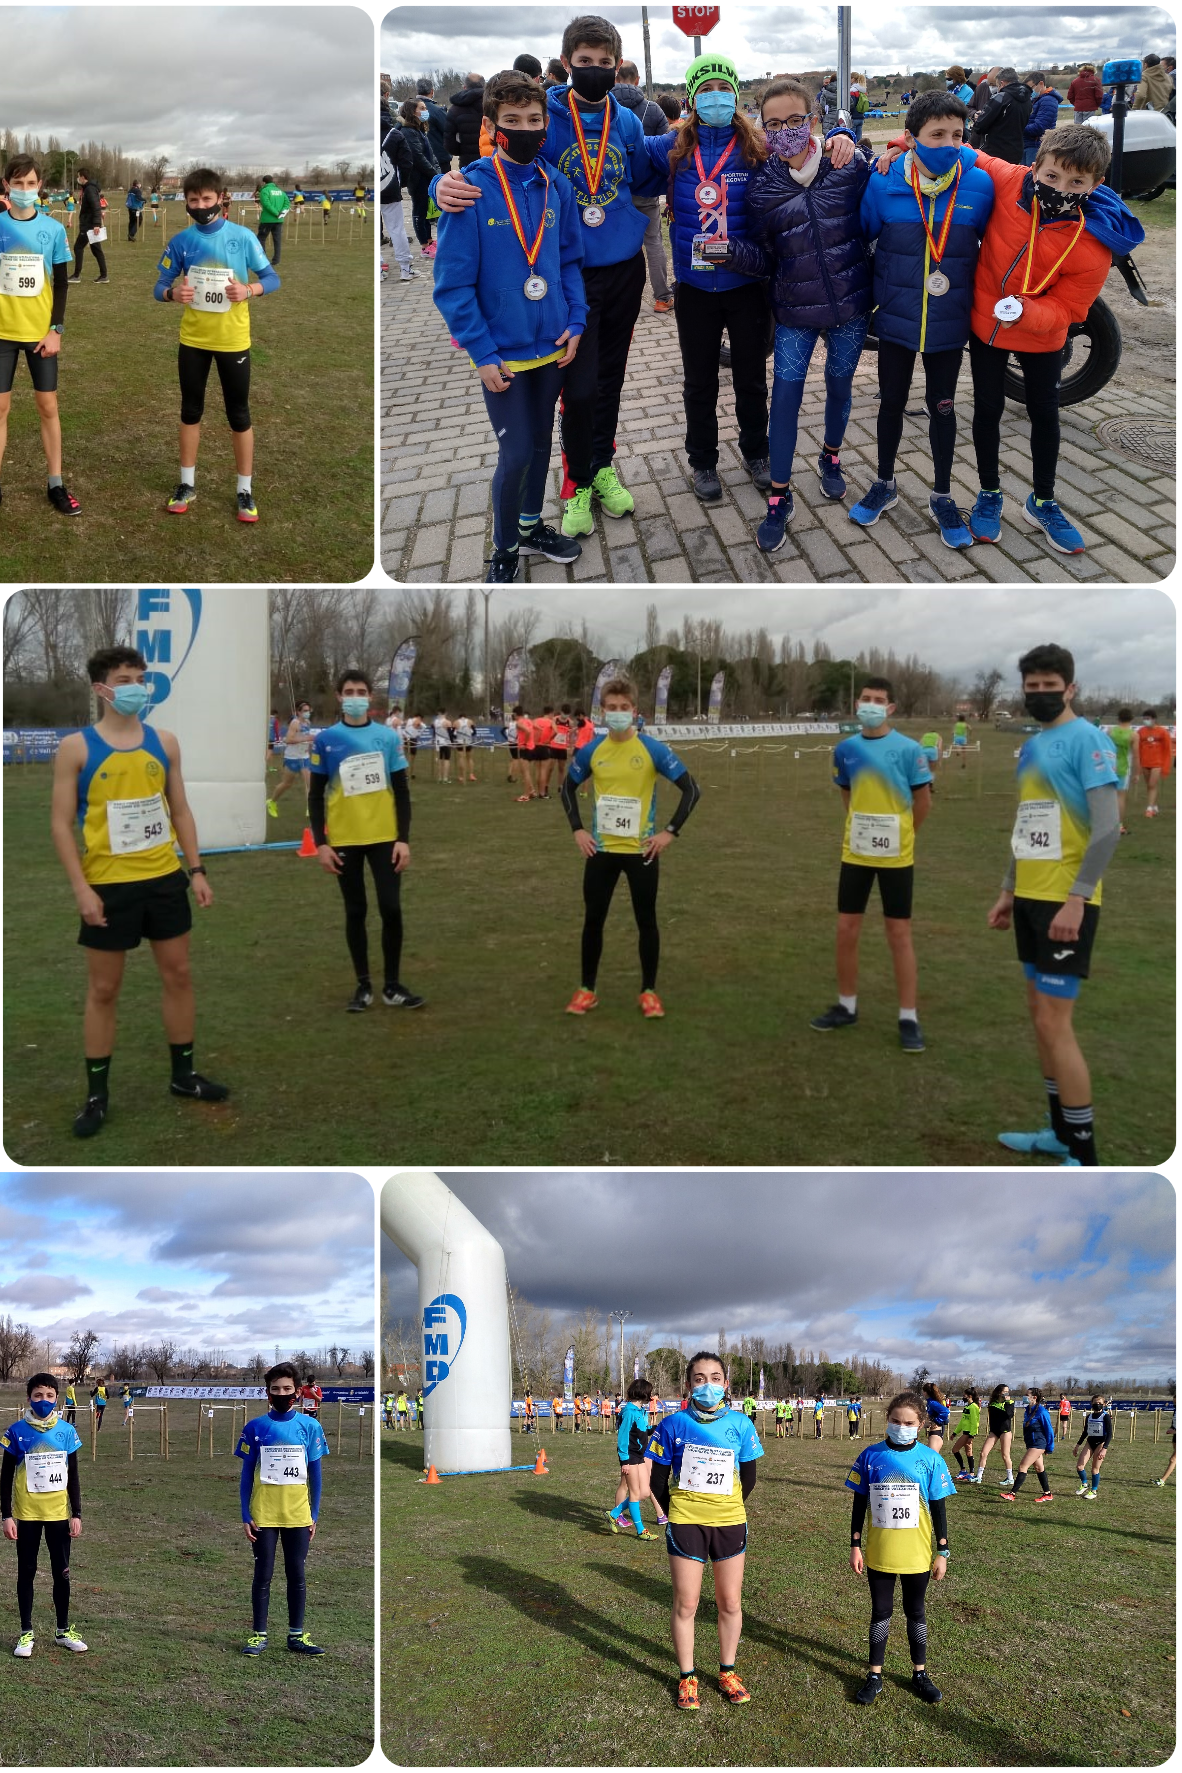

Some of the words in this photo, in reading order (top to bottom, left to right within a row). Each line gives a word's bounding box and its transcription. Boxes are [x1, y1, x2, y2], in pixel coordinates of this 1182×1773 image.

[677, 6, 715, 18] STOP
[18, 277, 36, 289] 599
[205, 291, 224, 304] 600
[365, 772, 381, 785] 539
[615, 817, 631, 829] 541
[144, 821, 163, 840] 543
[871, 836, 890, 849] 540
[1029, 831, 1050, 848] 542
[423, 1307, 450, 1382] FMD
[49, 1473, 63, 1484] 444
[283, 1467, 300, 1478] 443
[705, 1472, 725, 1486] 237
[891, 1507, 911, 1520] 236
